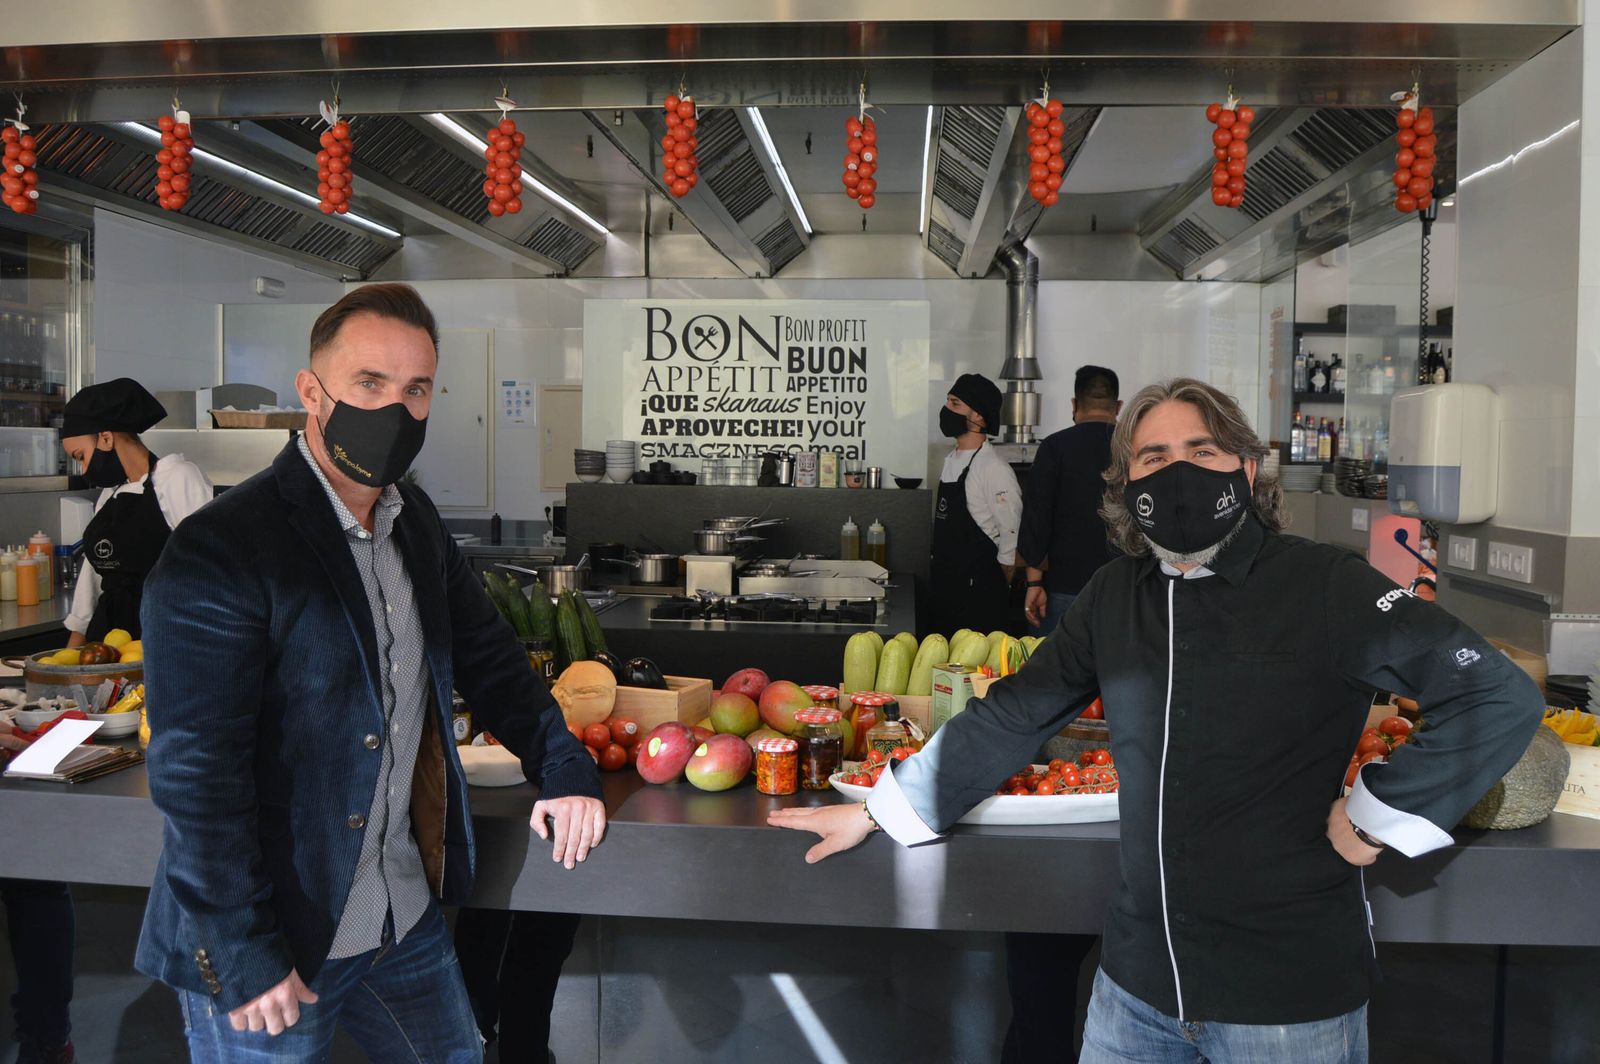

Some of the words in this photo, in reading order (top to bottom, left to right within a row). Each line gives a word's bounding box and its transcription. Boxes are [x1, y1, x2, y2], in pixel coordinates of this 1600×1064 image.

[641, 307, 785, 362] BON
[785, 316, 814, 343] BON
[819, 319, 868, 342] PROFIT
[787, 346, 868, 375] BUON
[640, 360, 783, 393] APPÉTIT
[786, 376, 868, 394] APPETITO
[640, 394, 699, 417] ¡QUE
[702, 386, 801, 413] skanaus
[806, 396, 866, 420] Enjoy
[640, 418, 804, 437] APROVECHE!
[807, 419, 866, 442] your
[1216, 483, 1236, 511] ah!
